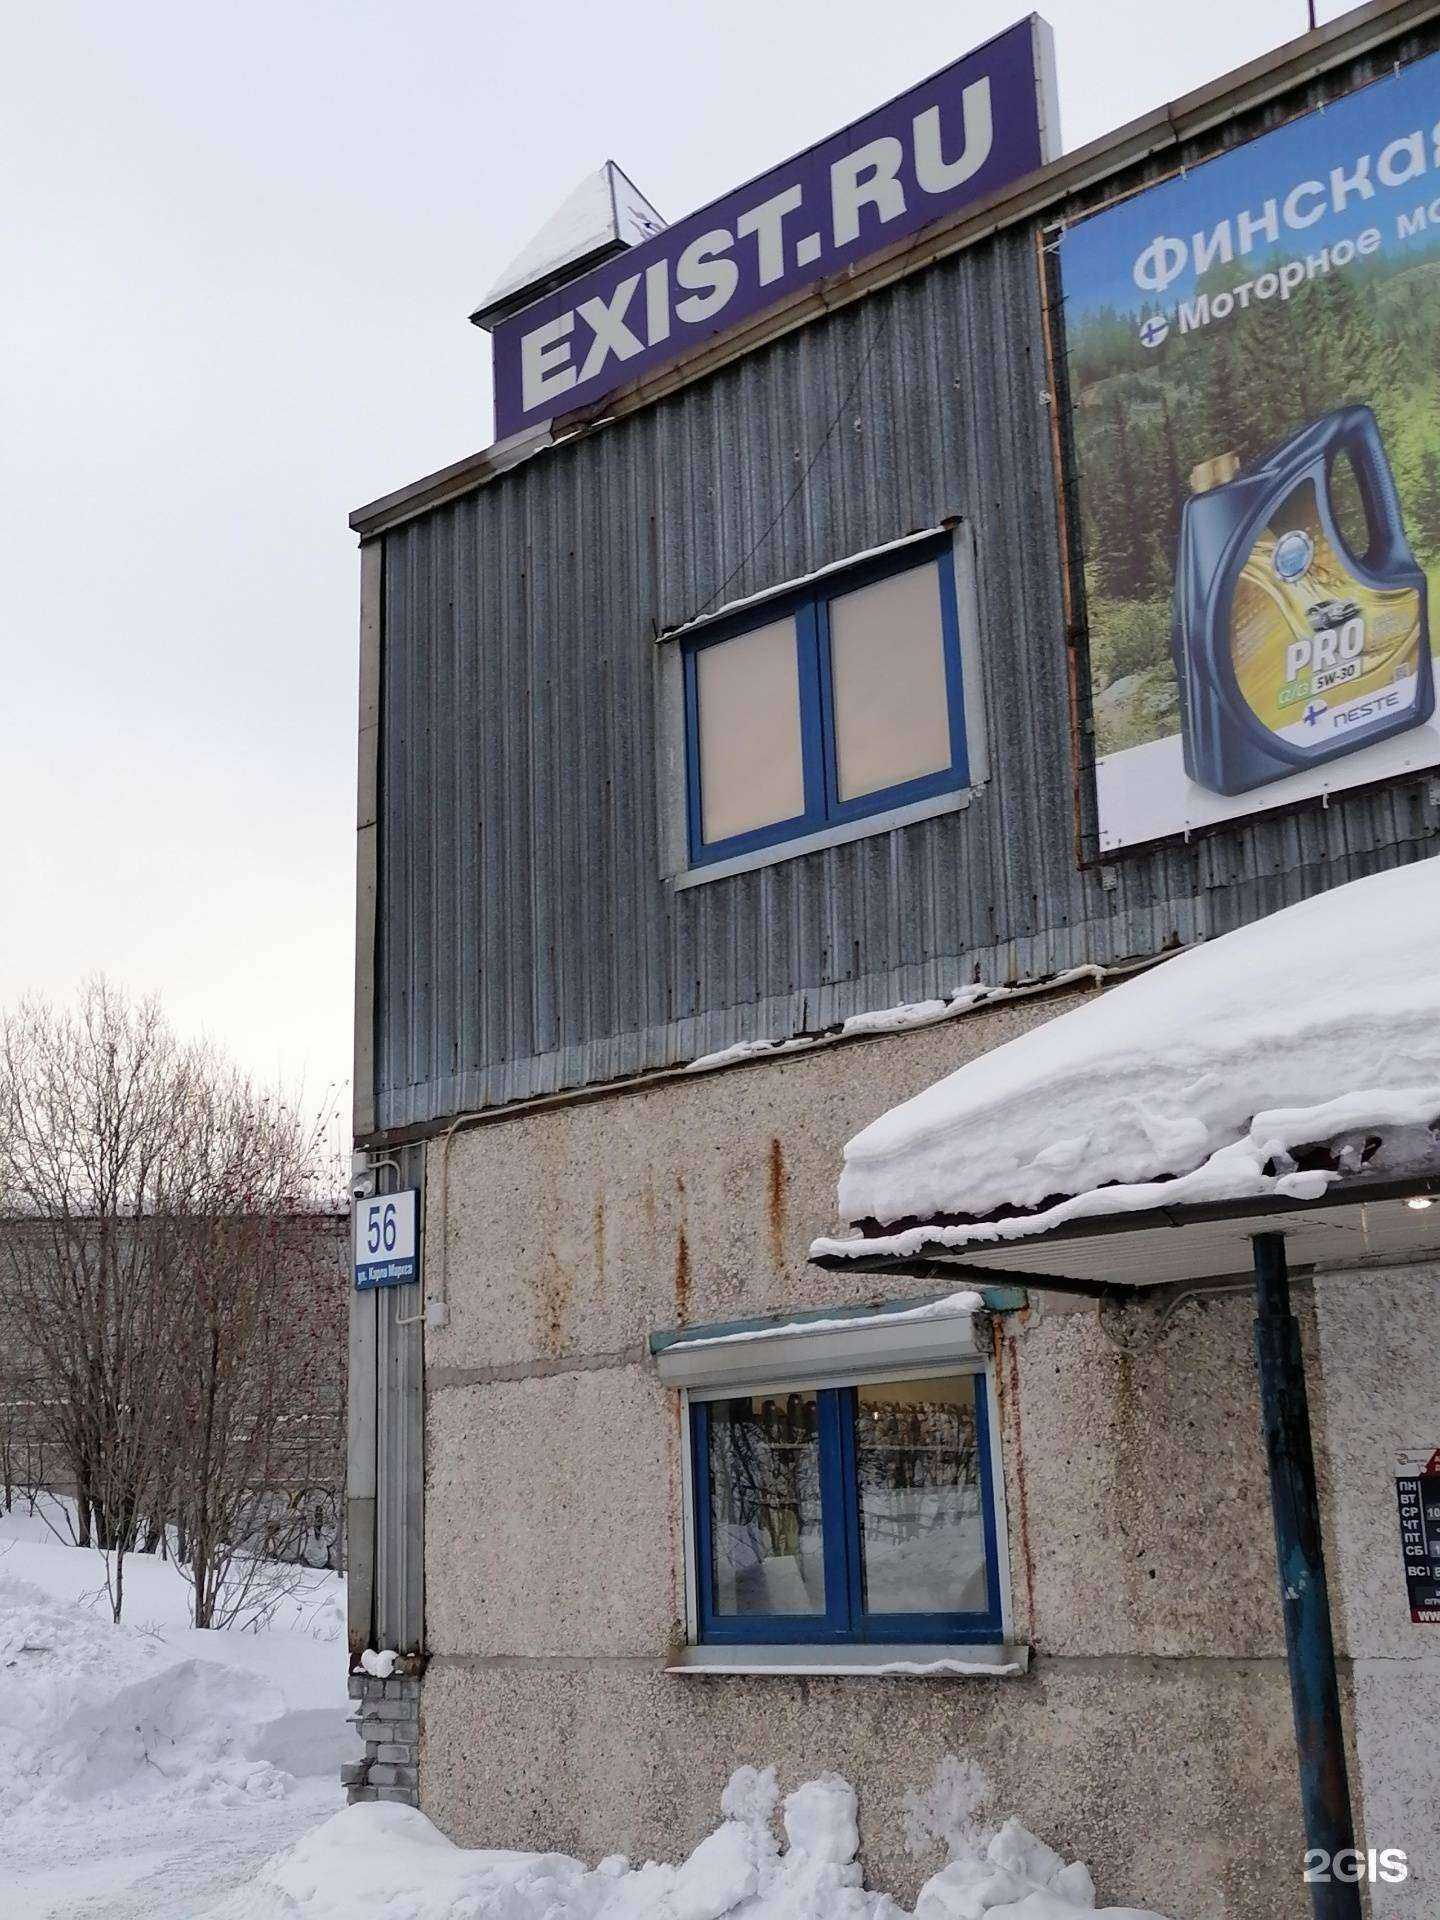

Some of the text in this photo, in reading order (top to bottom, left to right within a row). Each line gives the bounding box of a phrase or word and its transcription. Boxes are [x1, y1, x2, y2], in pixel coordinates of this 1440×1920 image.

[1133, 119, 1440, 292] Финска
[521, 75, 993, 412] EXIST.RU
[1177, 228, 1382, 335] Моторное
[1286, 617, 1365, 683] PRO
[1317, 664, 1356, 690] 5W-30
[368, 1203, 396, 1254] 56
[1399, 1481, 1417, 1491] ПН
[1400, 1494, 1417, 1504] ВТ
[1401, 1506, 1419, 1517] СР
[1402, 1520, 1419, 1530] ЧТ
[1404, 1533, 1421, 1543] ПТ
[1405, 1545, 1424, 1556] СБ
